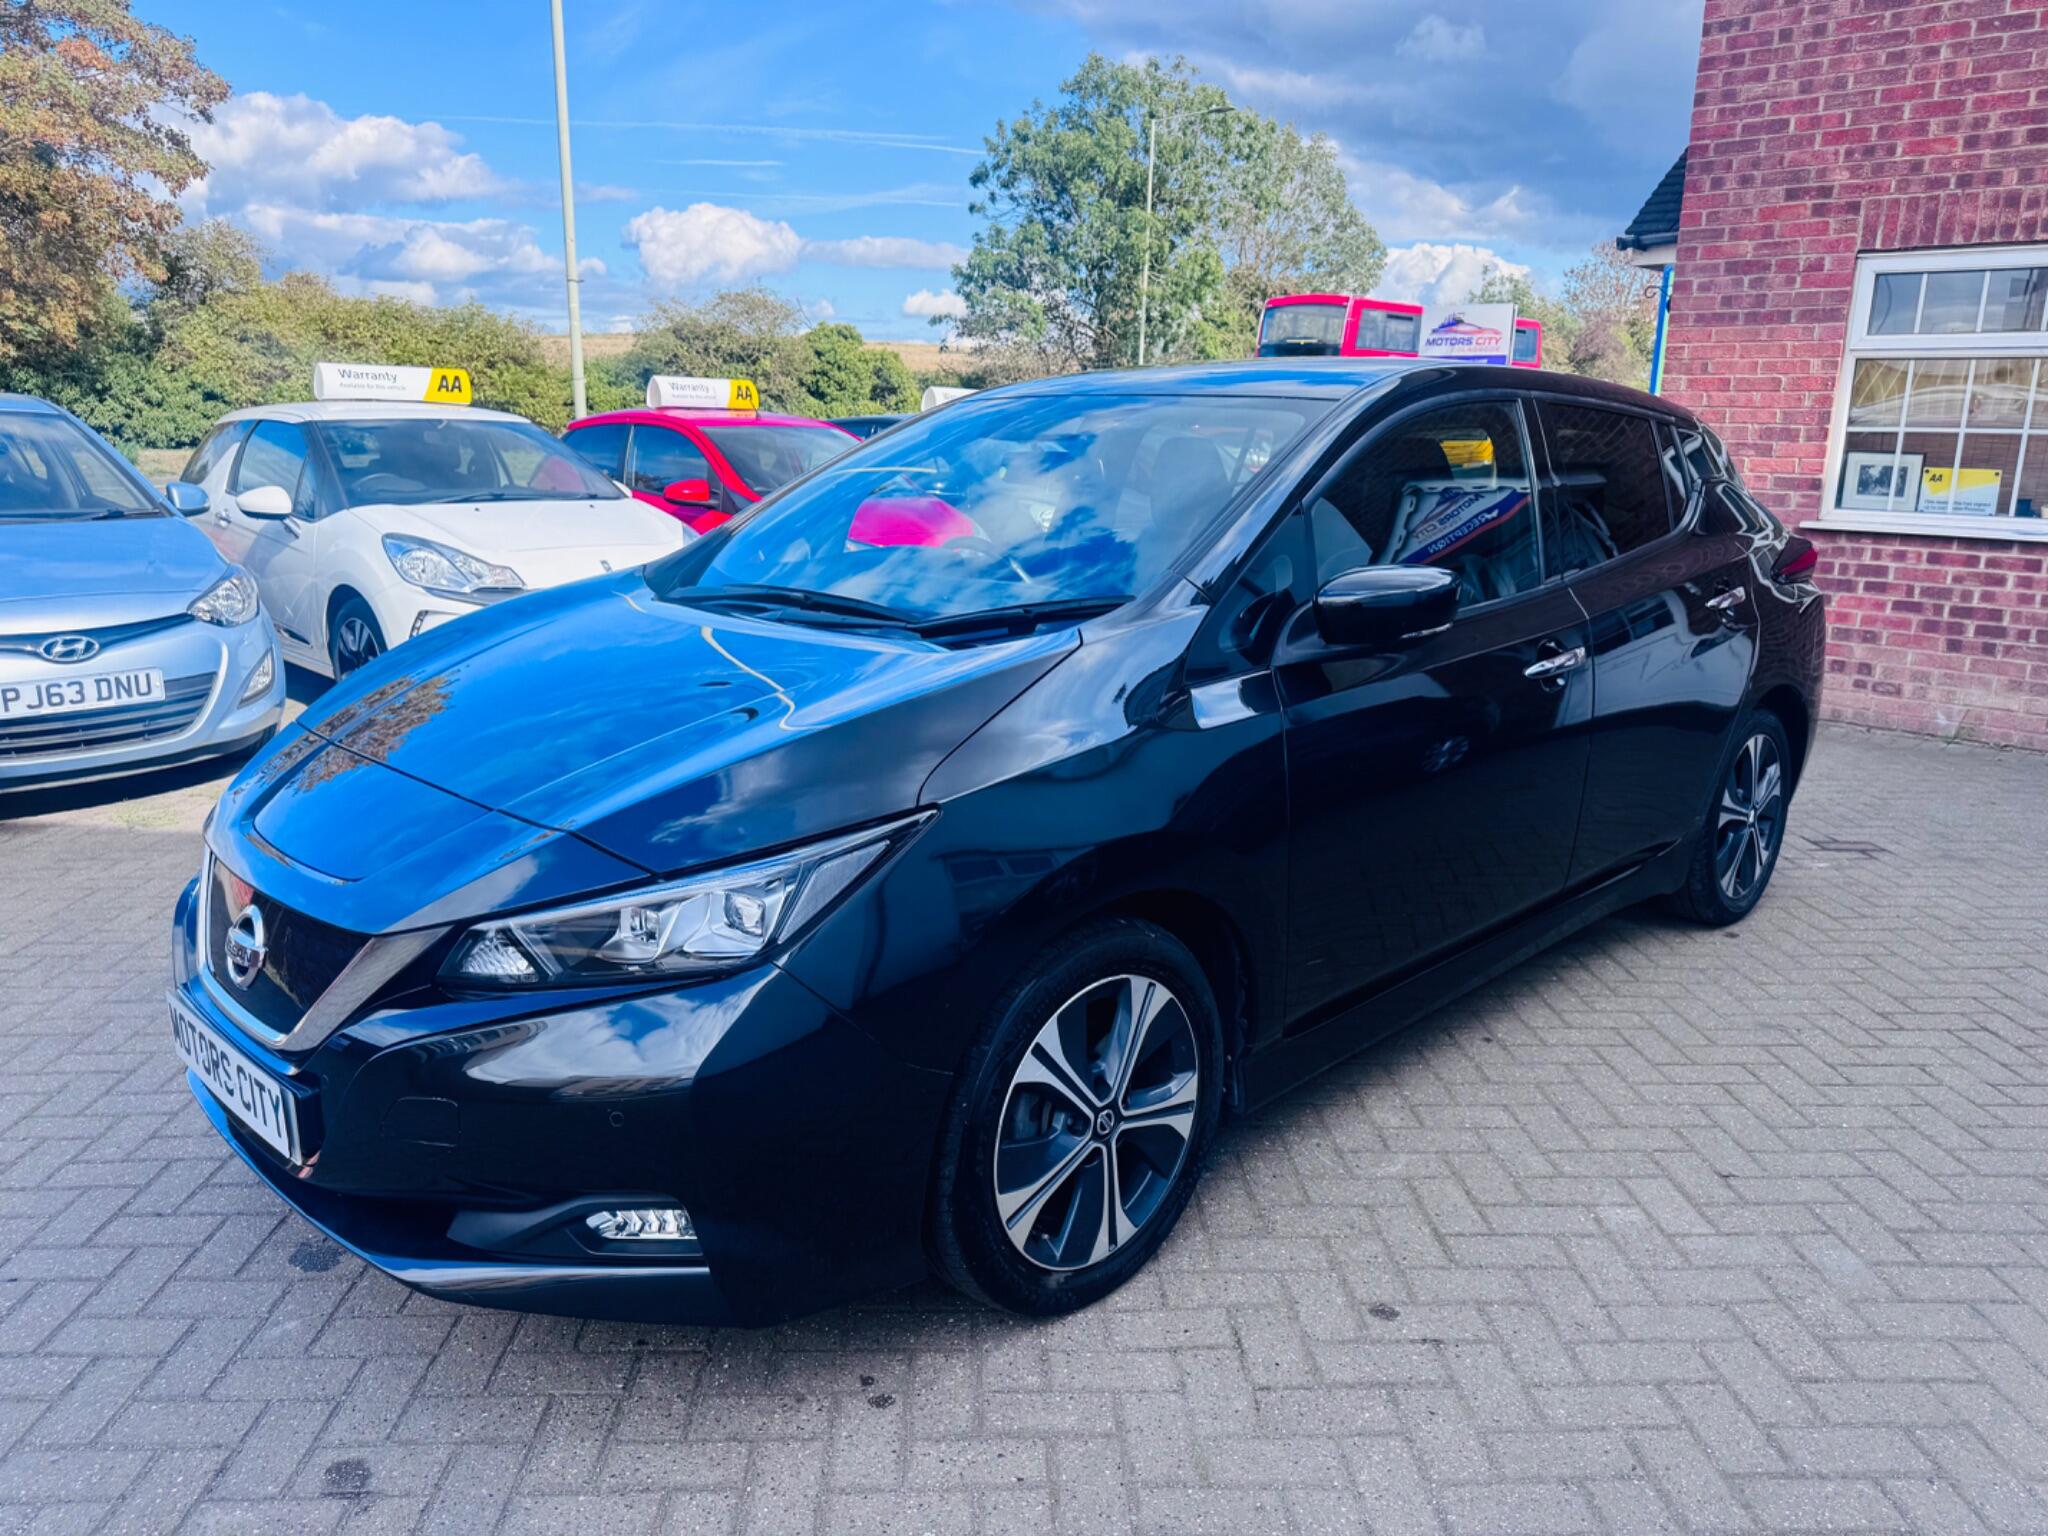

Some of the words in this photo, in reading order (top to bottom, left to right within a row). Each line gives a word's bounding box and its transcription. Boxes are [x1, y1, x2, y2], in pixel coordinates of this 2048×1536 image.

[1425, 337, 1473, 346] MOTORS
[1475, 336, 1503, 346] CITY
[338, 369, 398, 384] Warranty
[437, 375, 462, 393] AA
[736, 385, 752, 400] AA
[1928, 473, 1943, 483] AA
[0, 680, 85, 712] PJ63
[94, 673, 153, 702] DNU
[168, 1002, 235, 1097] MOTORS
[236, 1063, 282, 1138] CITY
